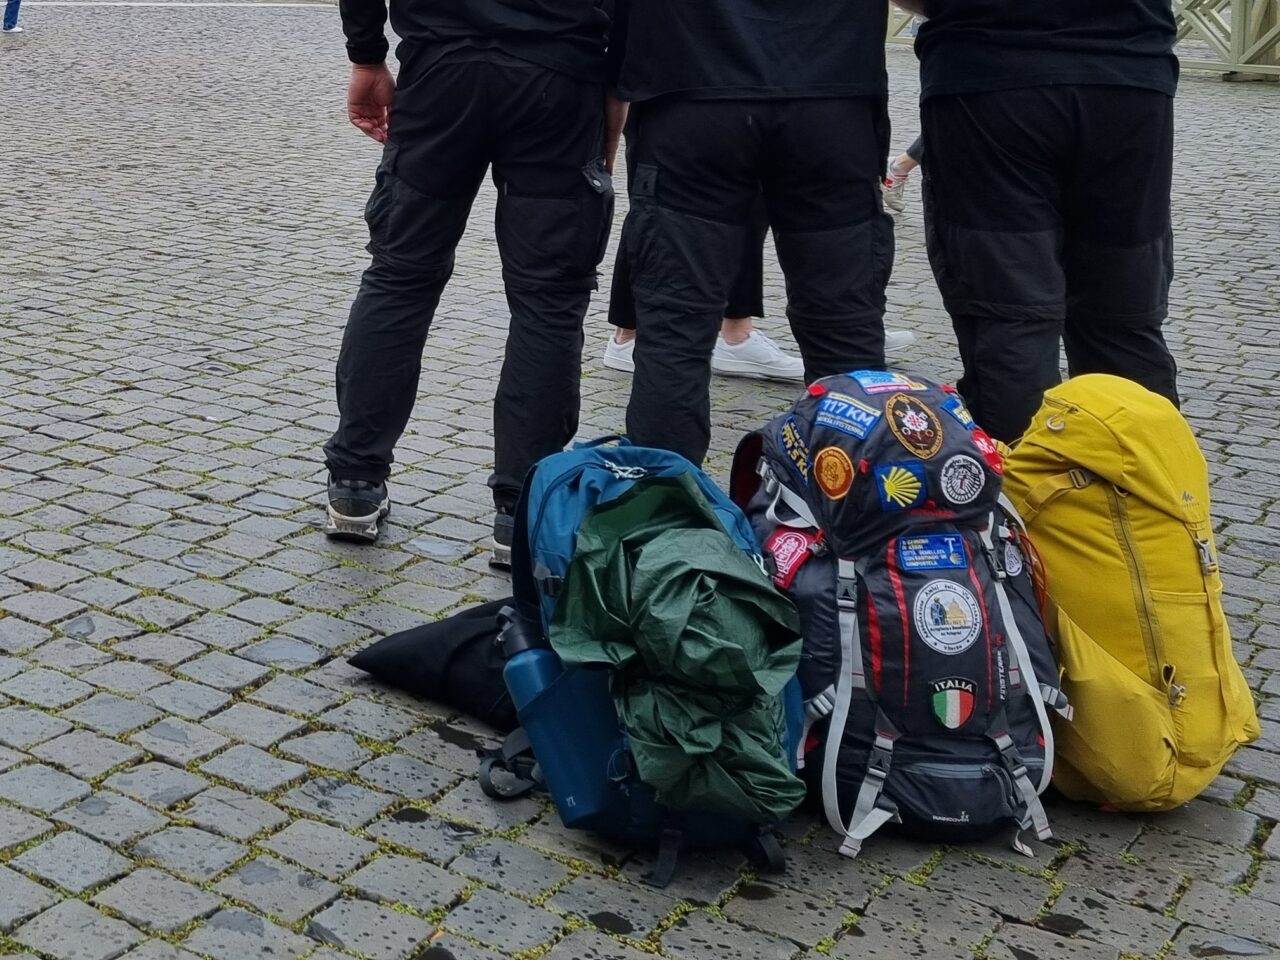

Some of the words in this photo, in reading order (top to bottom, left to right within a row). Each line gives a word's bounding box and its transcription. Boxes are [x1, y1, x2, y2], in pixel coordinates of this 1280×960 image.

[822, 399, 849, 414] 117
[846, 406, 875, 426] KM
[934, 680, 973, 692] ITALIA
